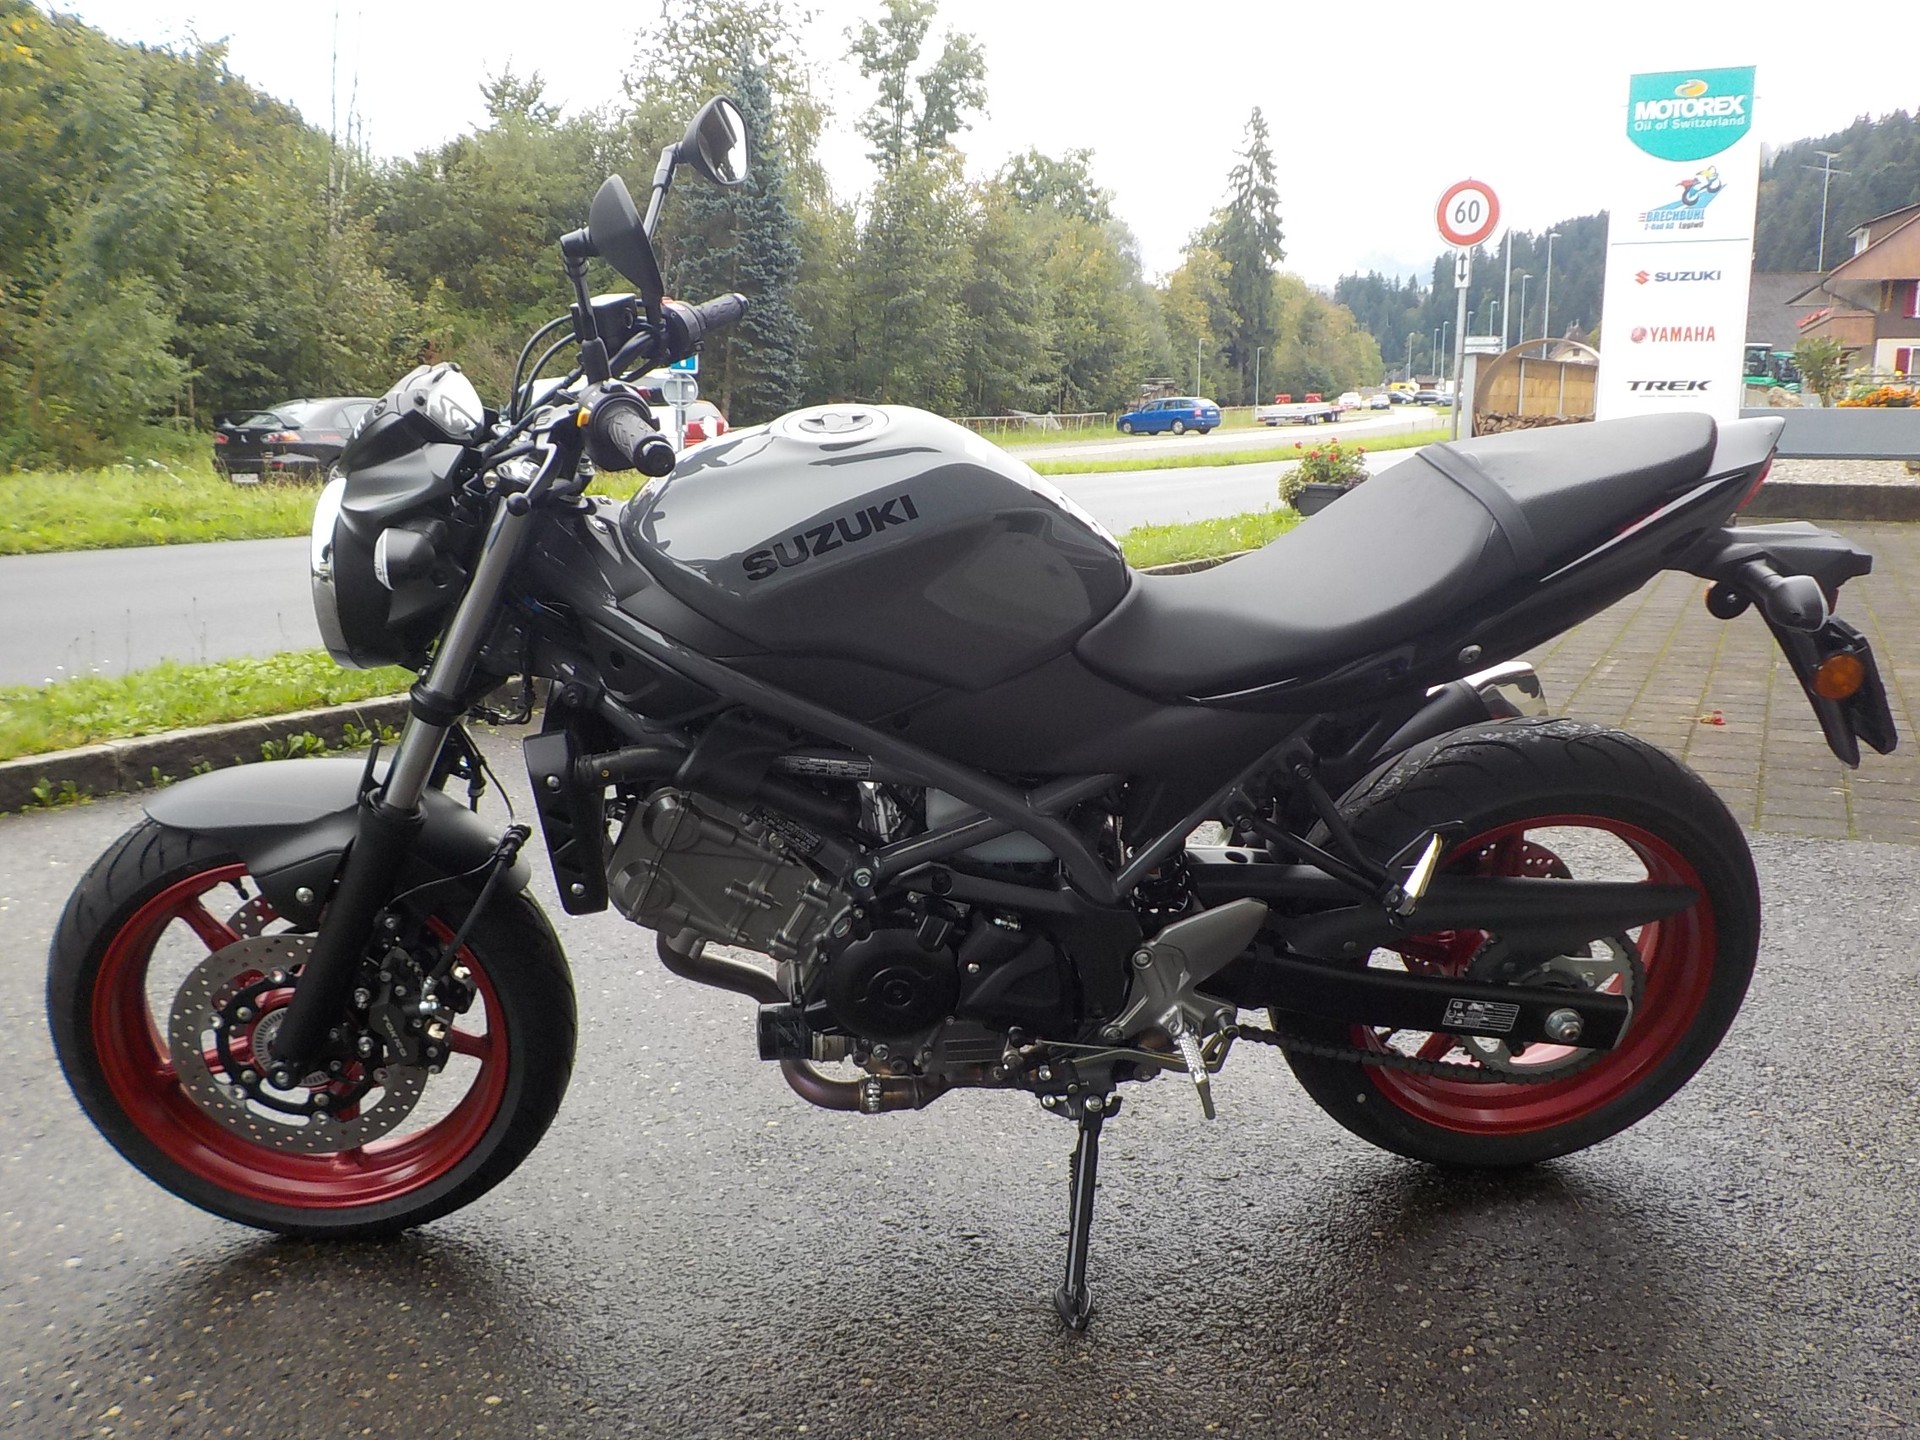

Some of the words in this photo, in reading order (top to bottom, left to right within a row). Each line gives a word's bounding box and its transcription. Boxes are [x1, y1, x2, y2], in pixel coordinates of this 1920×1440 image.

[1634, 95, 1746, 121] MOTOREX
[1633, 119, 1652, 132] Oil
[1655, 118, 1668, 131] of
[1671, 115, 1746, 130] Switzerland
[1455, 199, 1480, 224] 60
[1654, 270, 1722, 282] SUZUKI
[1650, 326, 1715, 343] YAMAHA
[1626, 380, 1712, 391] TREK
[742, 494, 919, 581] SUZUKI
